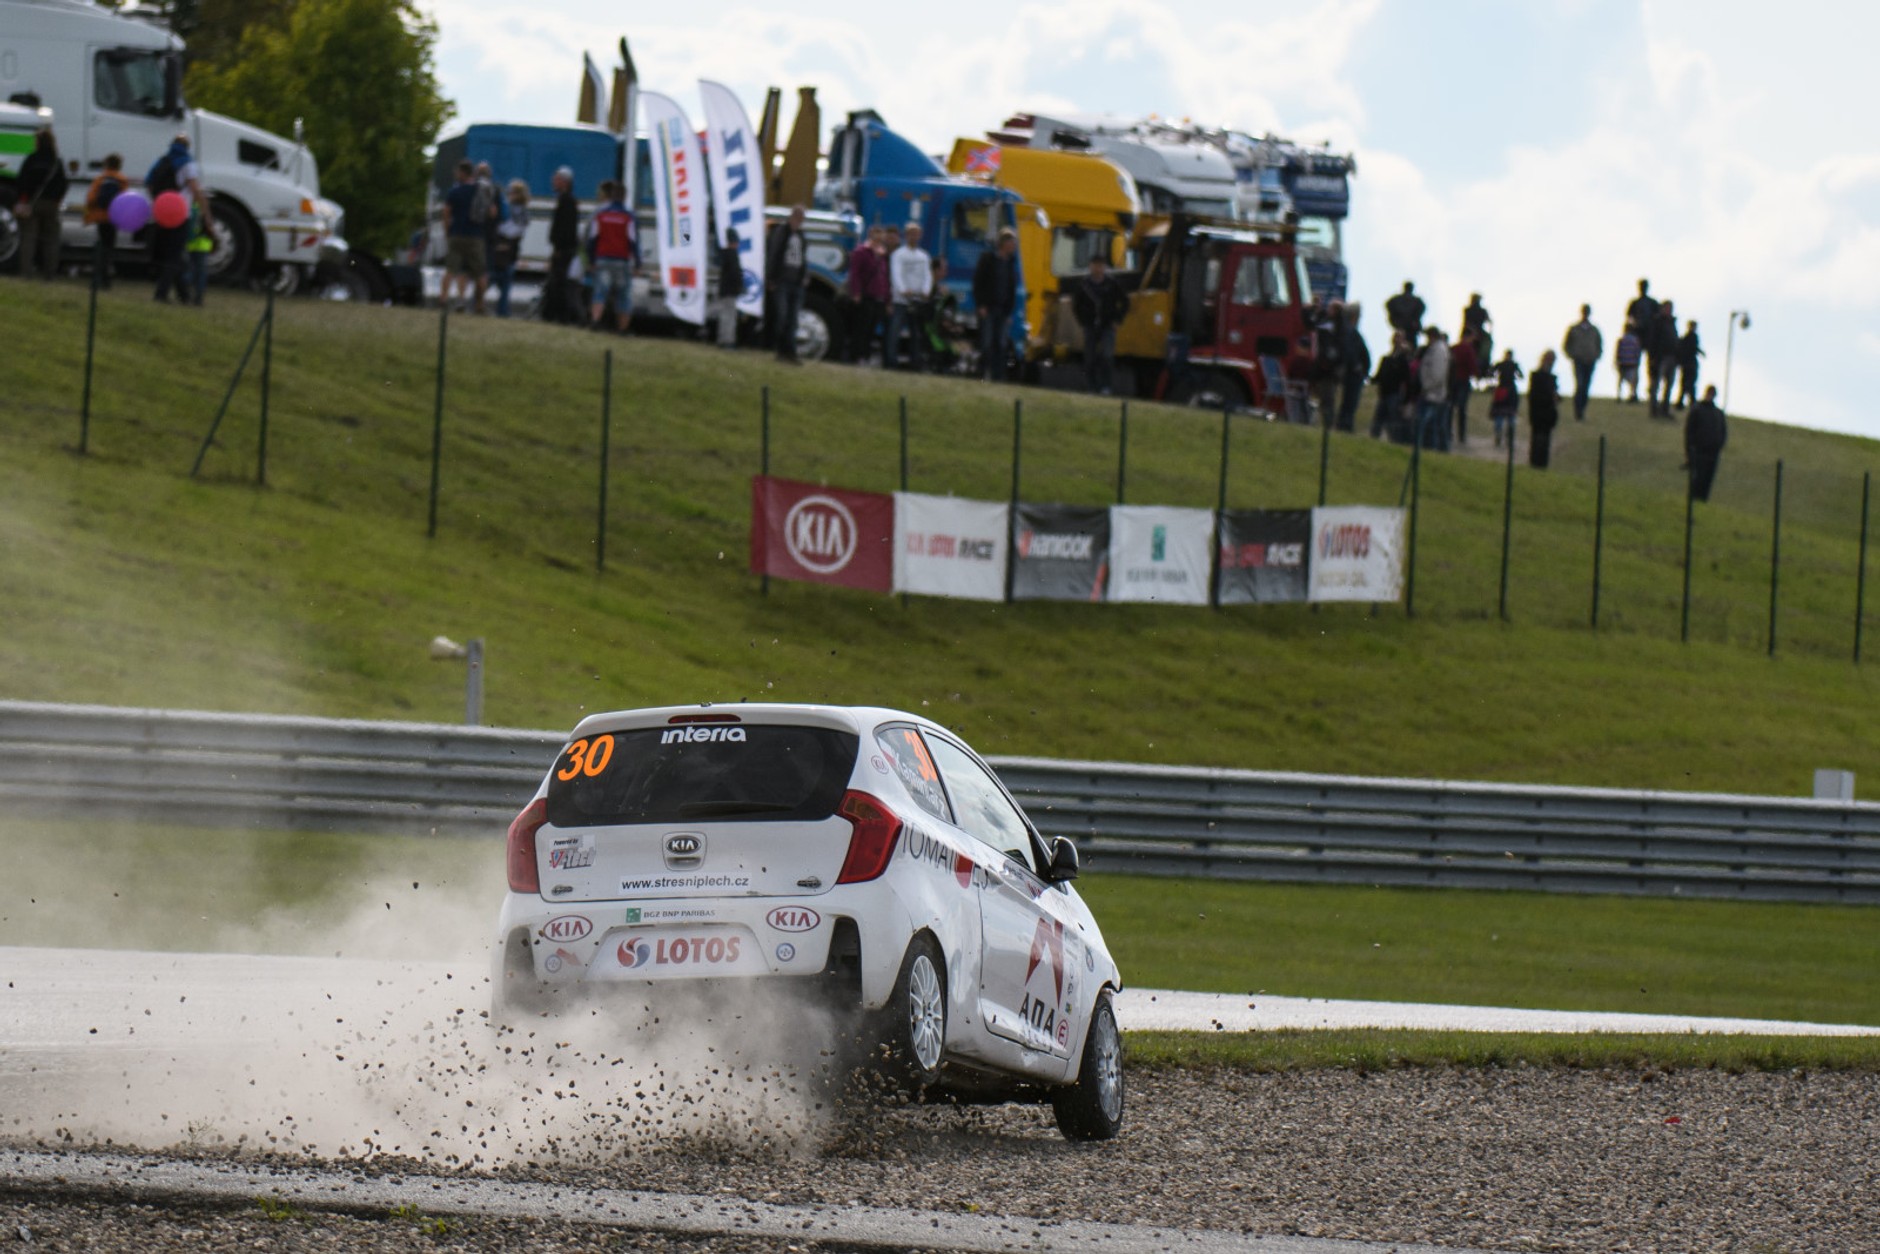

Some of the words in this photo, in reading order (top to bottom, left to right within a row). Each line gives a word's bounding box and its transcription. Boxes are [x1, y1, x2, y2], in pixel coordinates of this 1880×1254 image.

[799, 511, 843, 556] KIA
[661, 727, 747, 744] interia
[557, 734, 615, 781] 30
[672, 839, 695, 851] KIA
[622, 876, 749, 890] www.stresniplech.cz
[681, 909, 716, 917] PARIBAS
[775, 911, 810, 926] KIA
[551, 922, 584, 936] KIA
[656, 937, 740, 964] LOTOS
